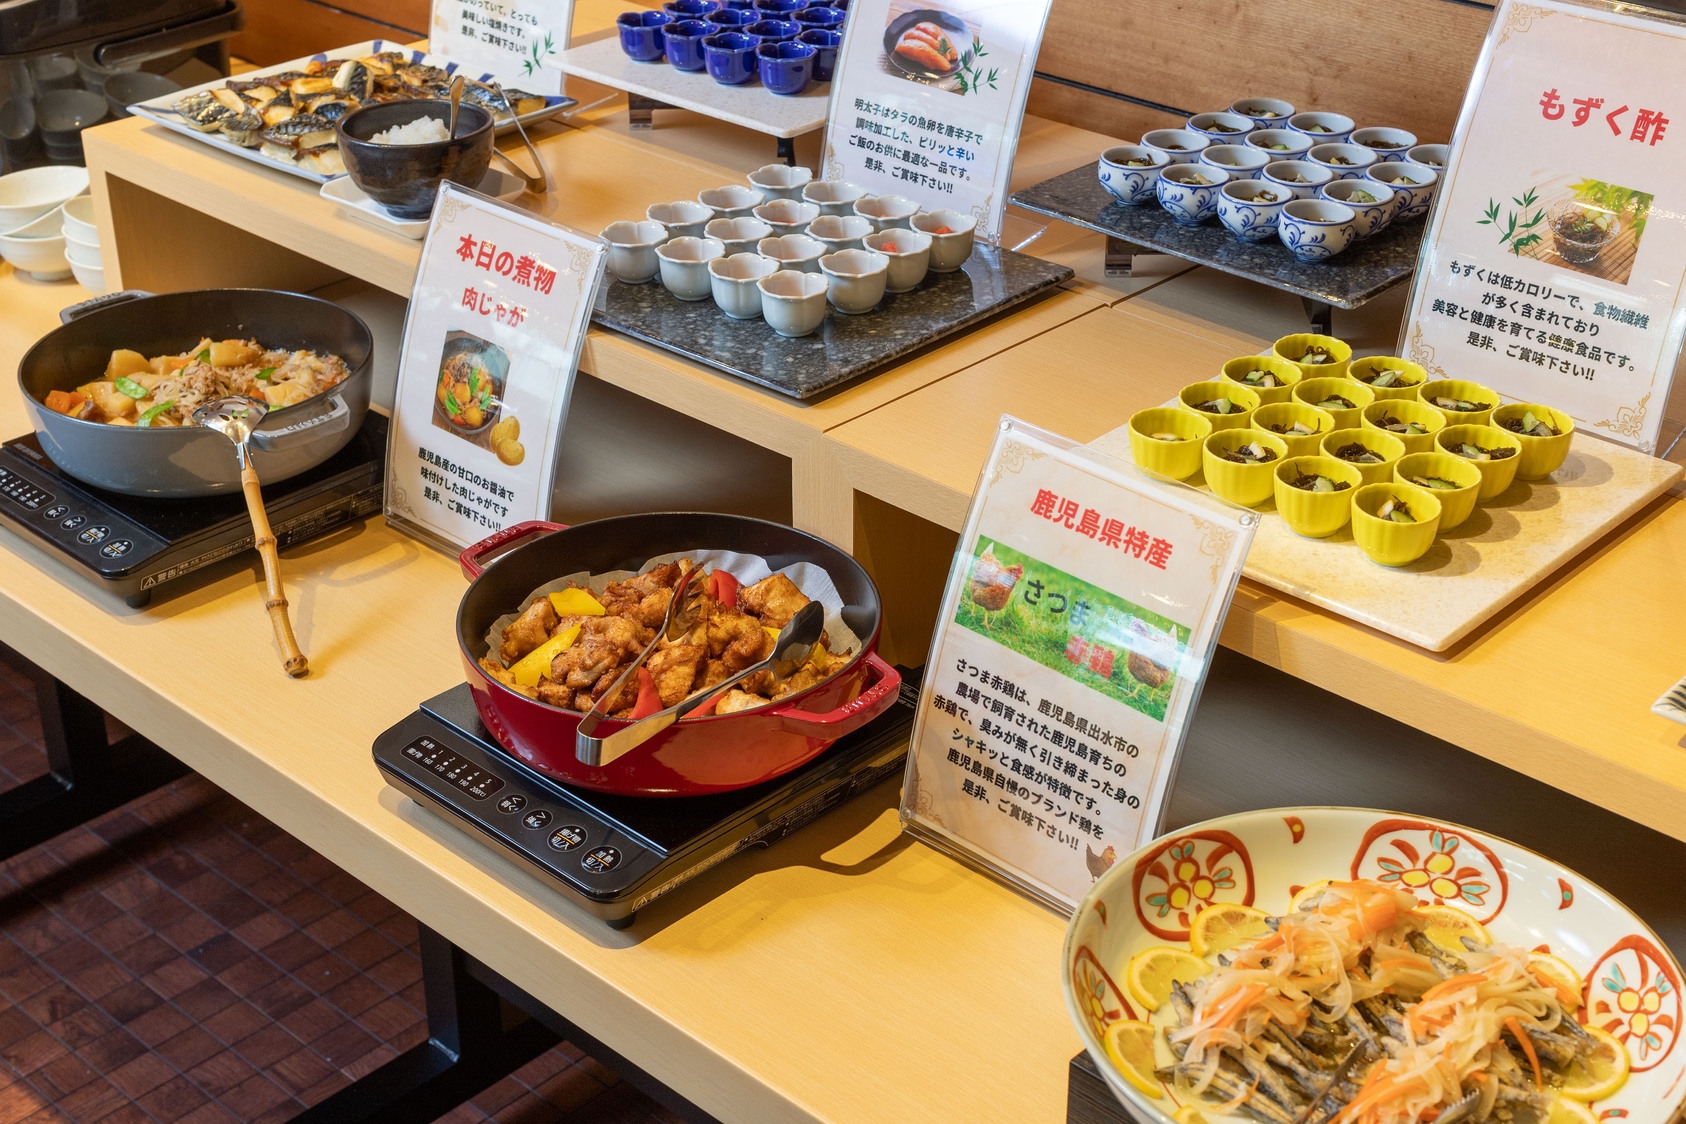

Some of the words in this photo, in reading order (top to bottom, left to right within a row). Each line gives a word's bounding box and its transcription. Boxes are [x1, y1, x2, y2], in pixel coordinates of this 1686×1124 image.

[457, 0, 538, 26] のっていて、とっても
[854, 98, 984, 146] 明太子はタラの魚卵を唐辛子で
[855, 117, 975, 161] 調味加工した、ピリッと辛い
[1539, 88, 1670, 147] もずく酢
[849, 134, 971, 181] ご飯のお供に最適な一品です。
[456, 233, 557, 295] 本日の煮物
[462, 287, 527, 328] 肉じゃが
[1449, 260, 1650, 330] もずくは低カロリーで、食物繊維
[1481, 292, 1601, 337] が多く含まれており
[1431, 298, 1635, 373] 美容と健康を育てる健康食品です。
[420, 466, 509, 517] 味付けした肉じゃがです
[1030, 488, 1174, 570] 鹿児島県特産
[1024, 579, 1091, 627] さつま
[1065, 636, 1115, 680] 赤鶏
[955, 681, 1127, 778] 農場で飼育された鹿児島育ちの
[956, 658, 1139, 759] さつま赤鶏は、鹿児島県出水市の
[933, 694, 1140, 810] 赤鶏で、臭みが無く引き締まった身の
[951, 727, 1101, 817] シャキッと食感が特徴です。
[946, 747, 1104, 841] 鹿児島県自慢のブランド鶏を
